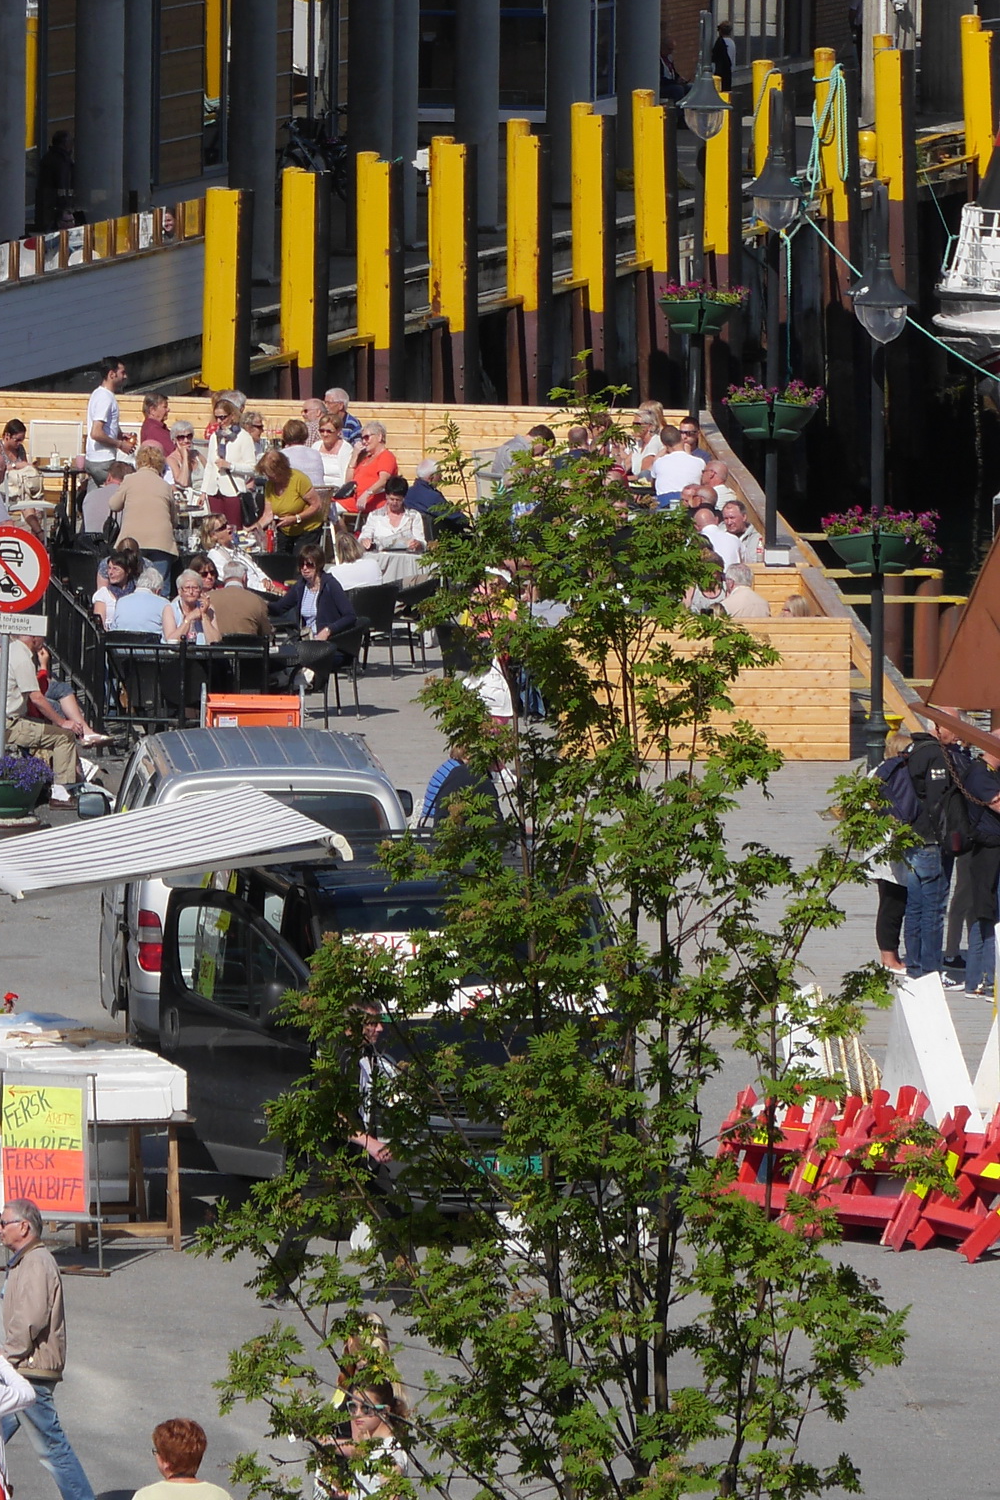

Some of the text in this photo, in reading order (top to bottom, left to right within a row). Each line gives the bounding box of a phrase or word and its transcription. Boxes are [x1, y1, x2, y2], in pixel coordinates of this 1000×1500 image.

[3, 615, 30, 625] torgsalg
[3, 1088, 52, 1131] FERSK
[5, 1148, 55, 1170] FERSK
[7, 1175, 83, 1201] HVALBIFF
